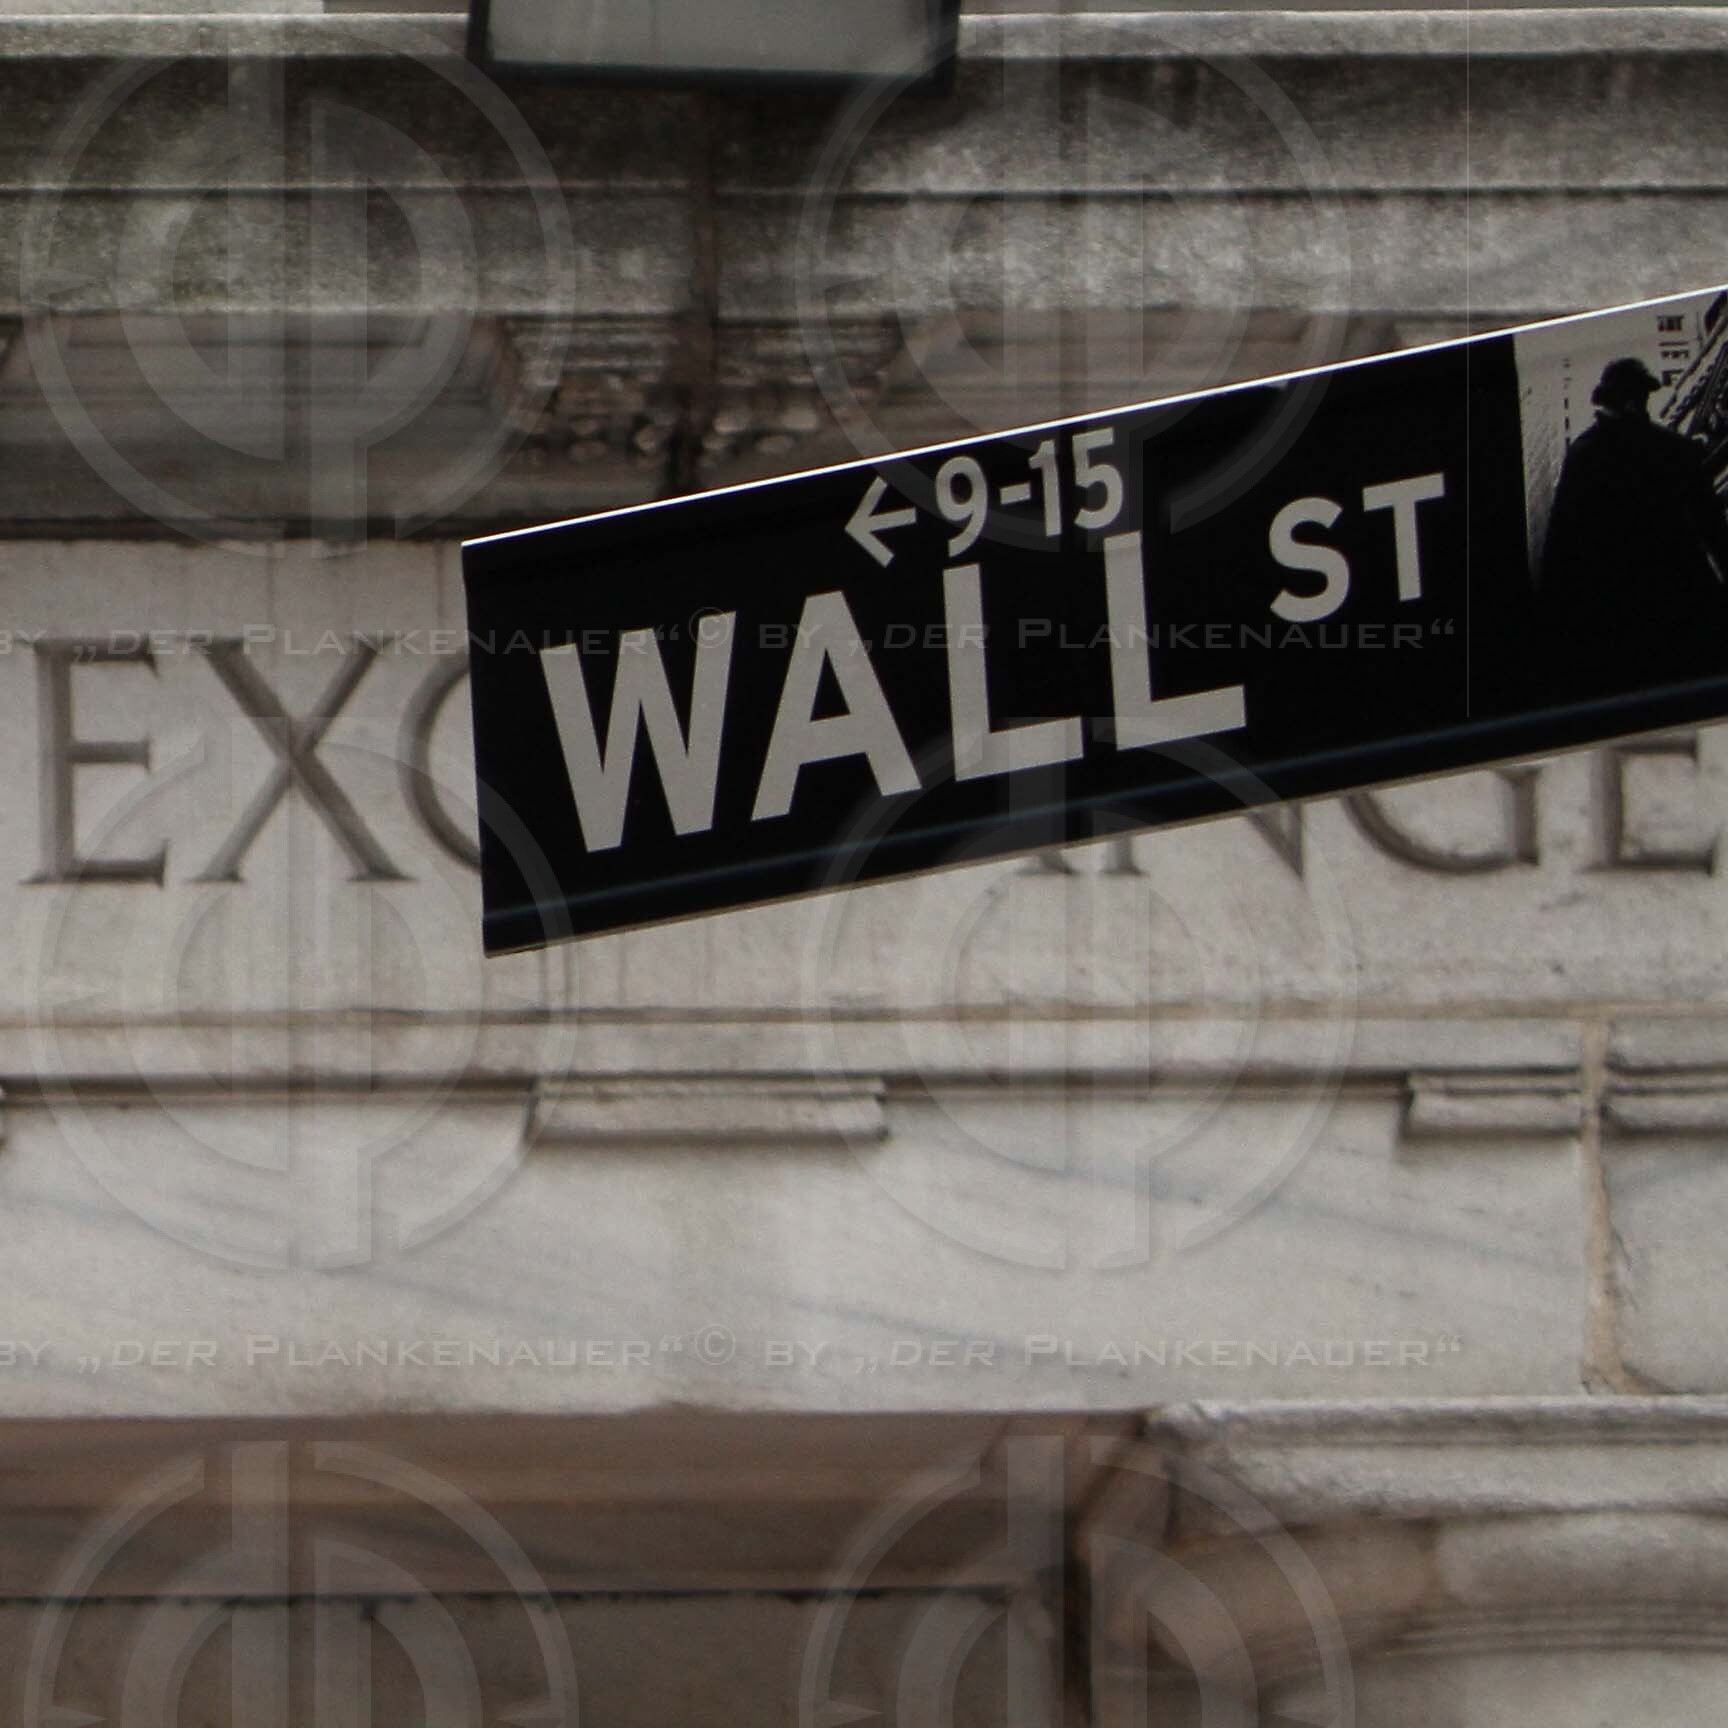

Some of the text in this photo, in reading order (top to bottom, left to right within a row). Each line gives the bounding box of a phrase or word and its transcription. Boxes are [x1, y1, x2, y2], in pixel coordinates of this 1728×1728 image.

[934, 426, 1124, 558] 9-15
[540, 472, 1446, 854] WALL ST
